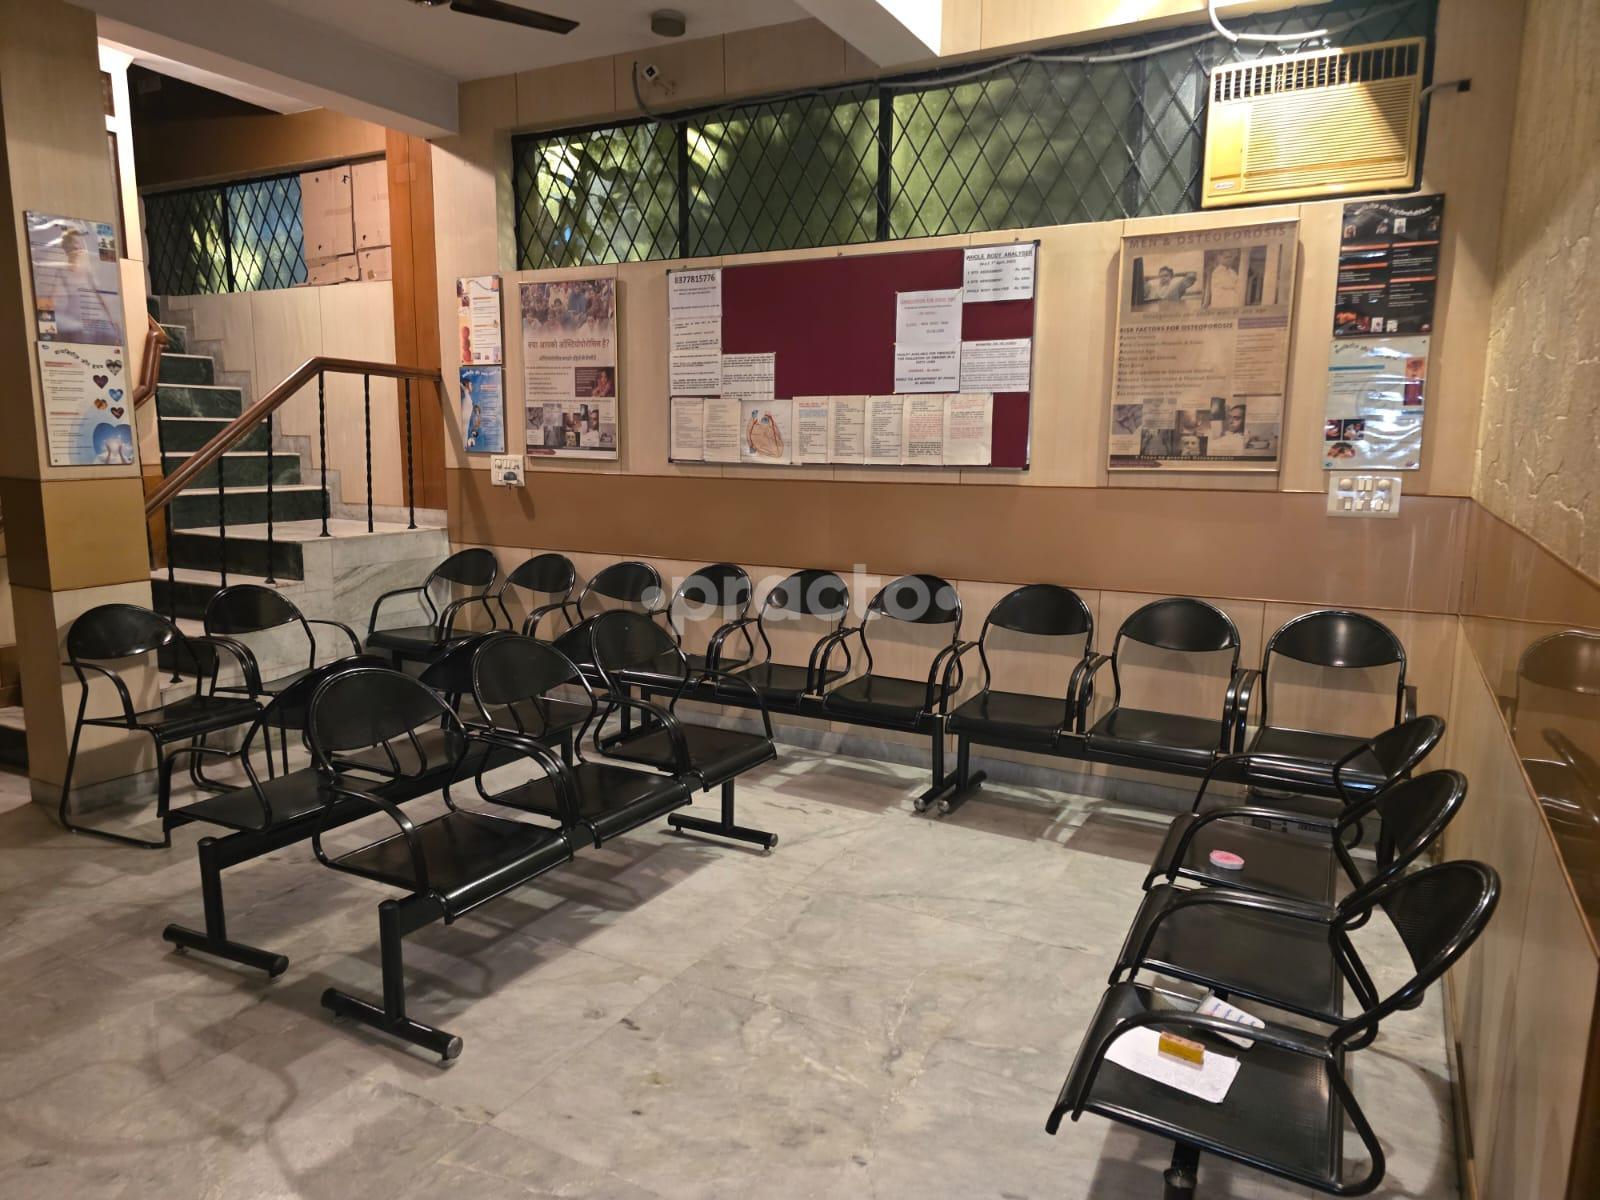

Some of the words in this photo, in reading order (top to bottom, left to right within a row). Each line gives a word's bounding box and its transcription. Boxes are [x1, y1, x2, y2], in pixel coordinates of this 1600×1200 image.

[1129, 237, 1158, 249] MEN
[1163, 236, 1171, 245] &
[1177, 227, 1287, 245] OSTEOPOROSIS
[966, 253, 985, 261] WHOLE
[987, 252, 1002, 260] BODY
[1136, 325, 1165, 333] FACTORS
[1166, 324, 1180, 332] FOR
[1181, 322, 1233, 331] OSTEOPOROSIS
[540, 338, 558, 349] आपको
